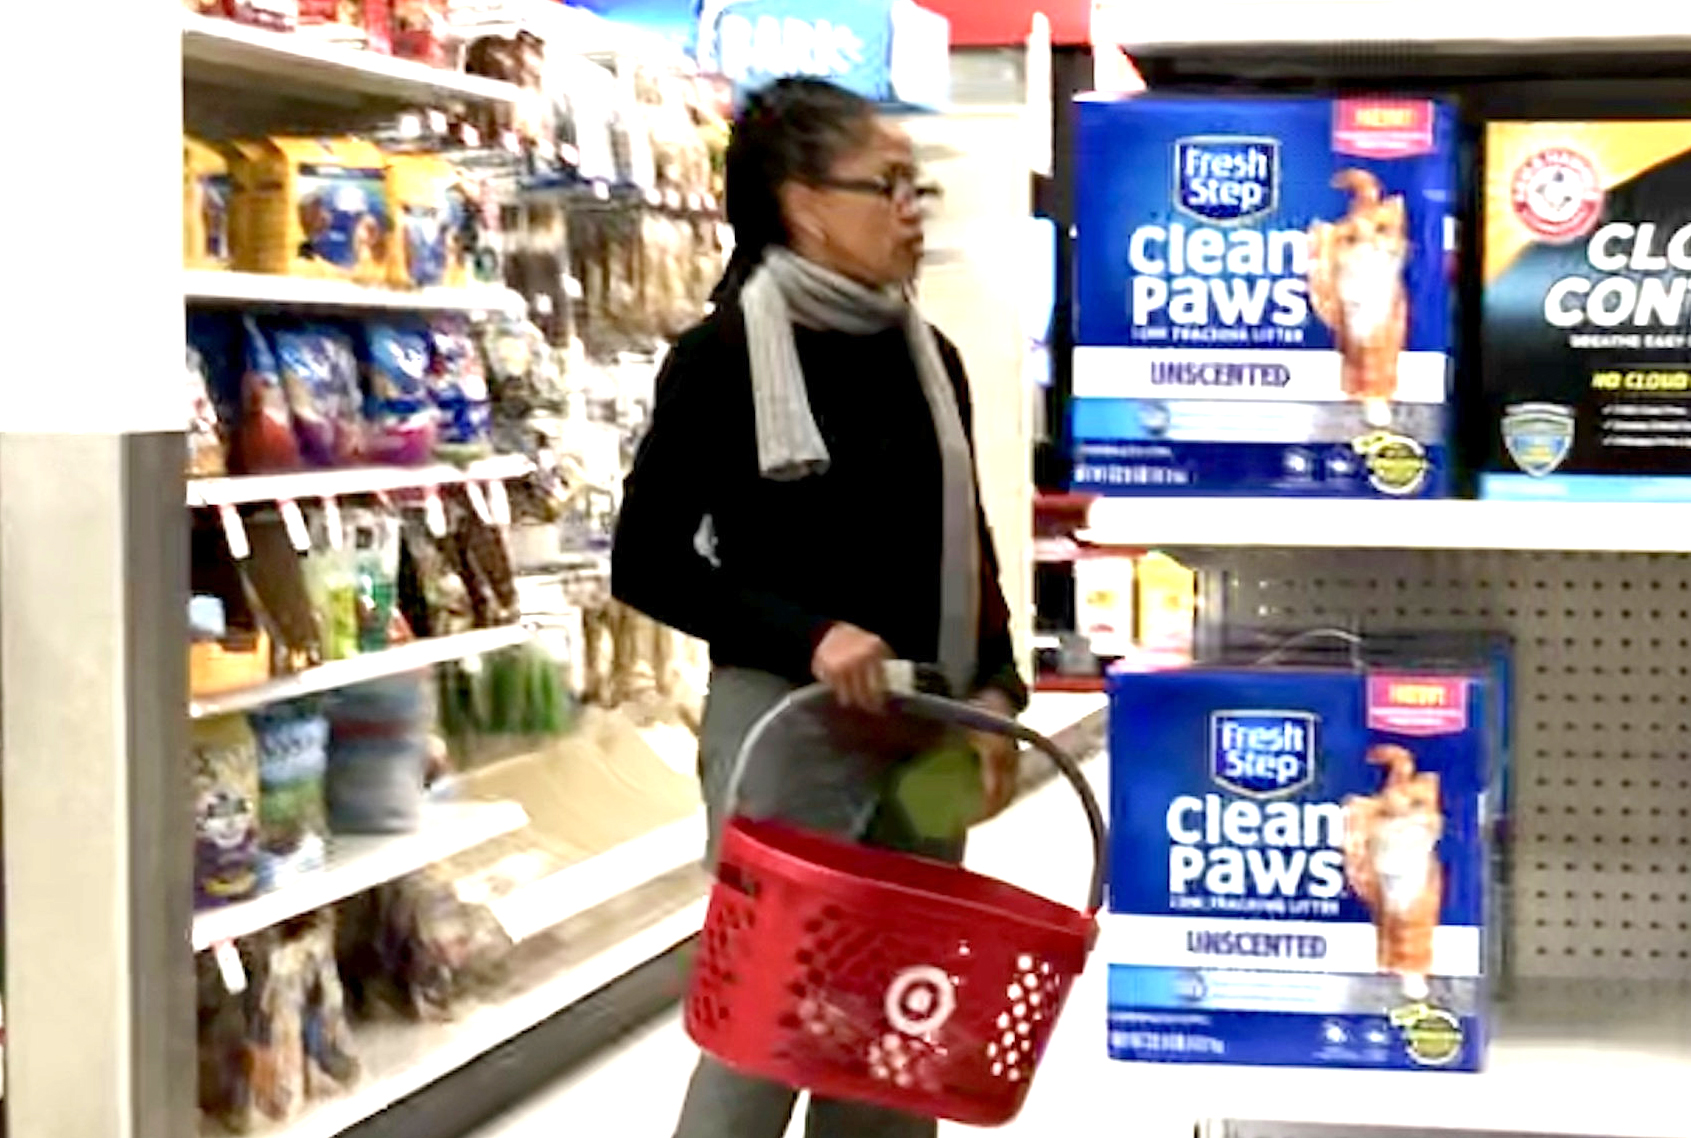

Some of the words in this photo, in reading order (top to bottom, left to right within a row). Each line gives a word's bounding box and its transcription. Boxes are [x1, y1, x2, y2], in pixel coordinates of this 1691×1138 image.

[1185, 146, 1267, 177] Fresh
[1190, 179, 1262, 212] Step
[1543, 276, 1691, 327] CON
[1151, 362, 1291, 387] UNSCENTED
[1591, 372, 1622, 389] NO
[1624, 372, 1688, 389] CLOUD
[1221, 720, 1304, 752] Fresh
[1225, 749, 1299, 784] Step
[1186, 931, 1327, 959] UNSCENTED
